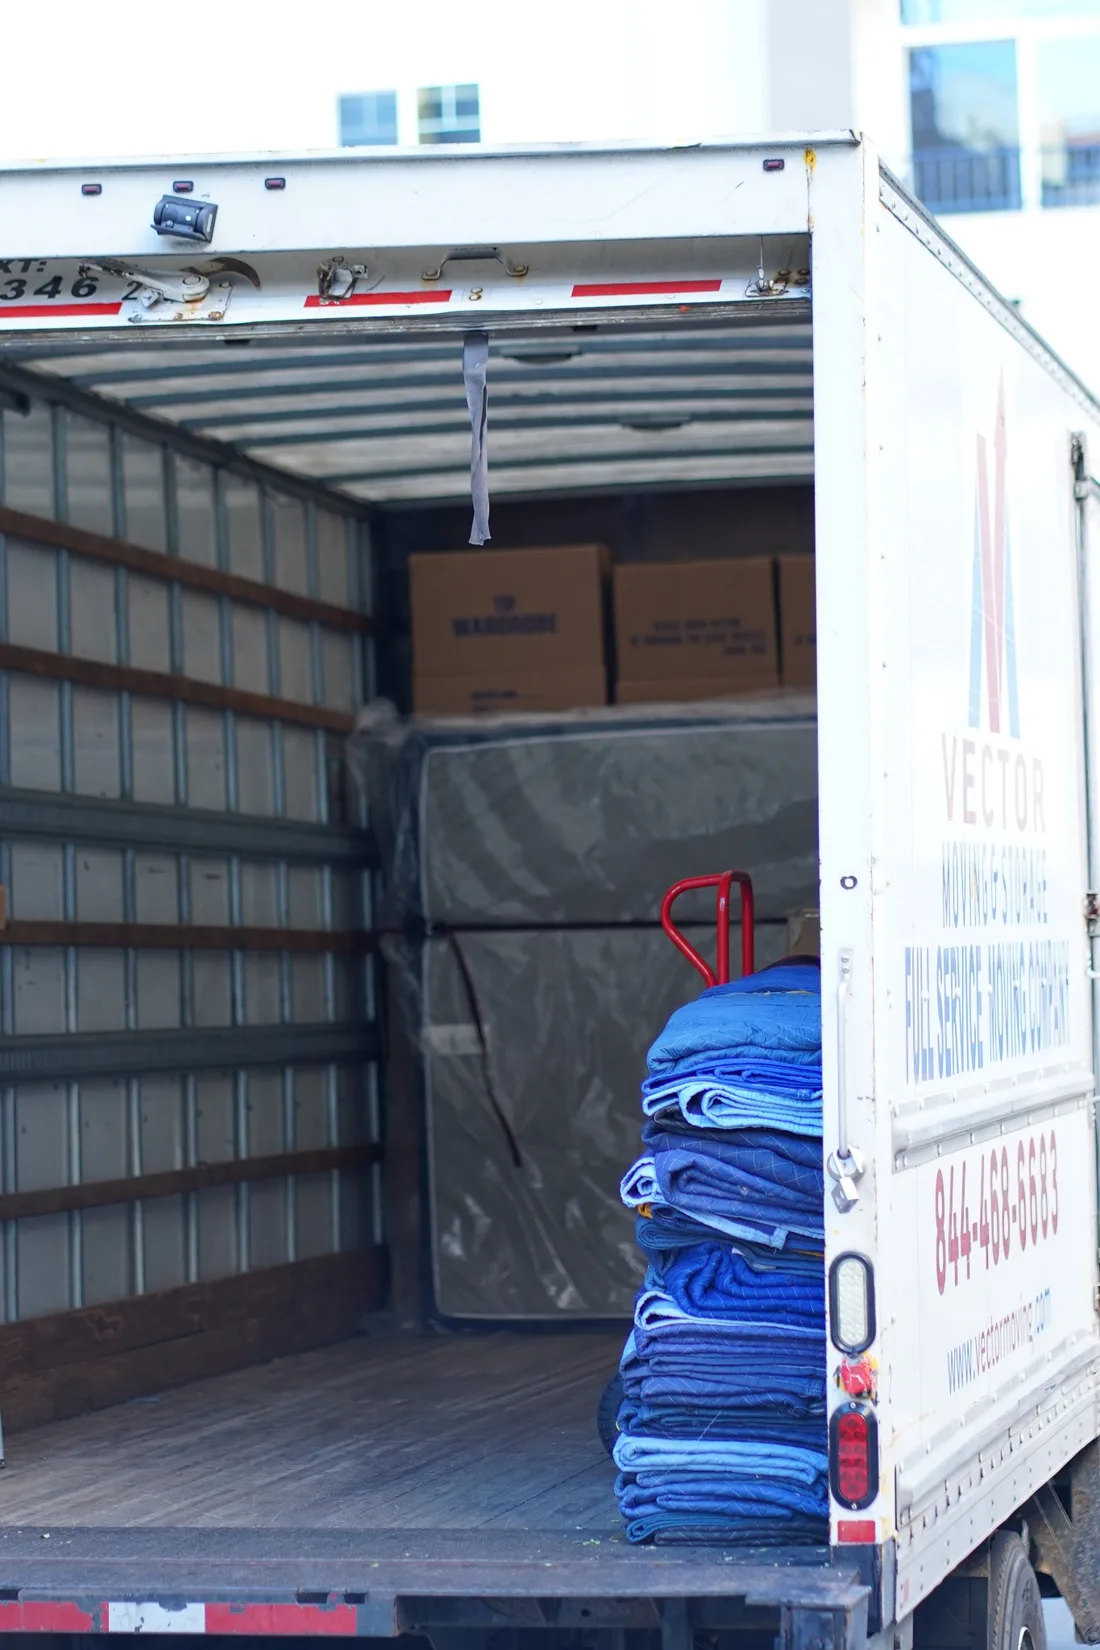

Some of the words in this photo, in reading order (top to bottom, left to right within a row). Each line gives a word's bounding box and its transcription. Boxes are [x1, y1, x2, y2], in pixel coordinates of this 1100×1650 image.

[941, 732, 1046, 833] VECTOR
[942, 840, 988, 928] MOVING
[1001, 843, 1048, 926] STORAGE
[905, 946, 934, 1084] FULL
[936, 944, 983, 1079] SERVICE
[988, 941, 1027, 1062] MOVING
[1028, 939, 1070, 1057] COMPANY
[935, 1130, 1058, 1296] 844-468-6683
[947, 1288, 1051, 1395] www.vectormoving.com
